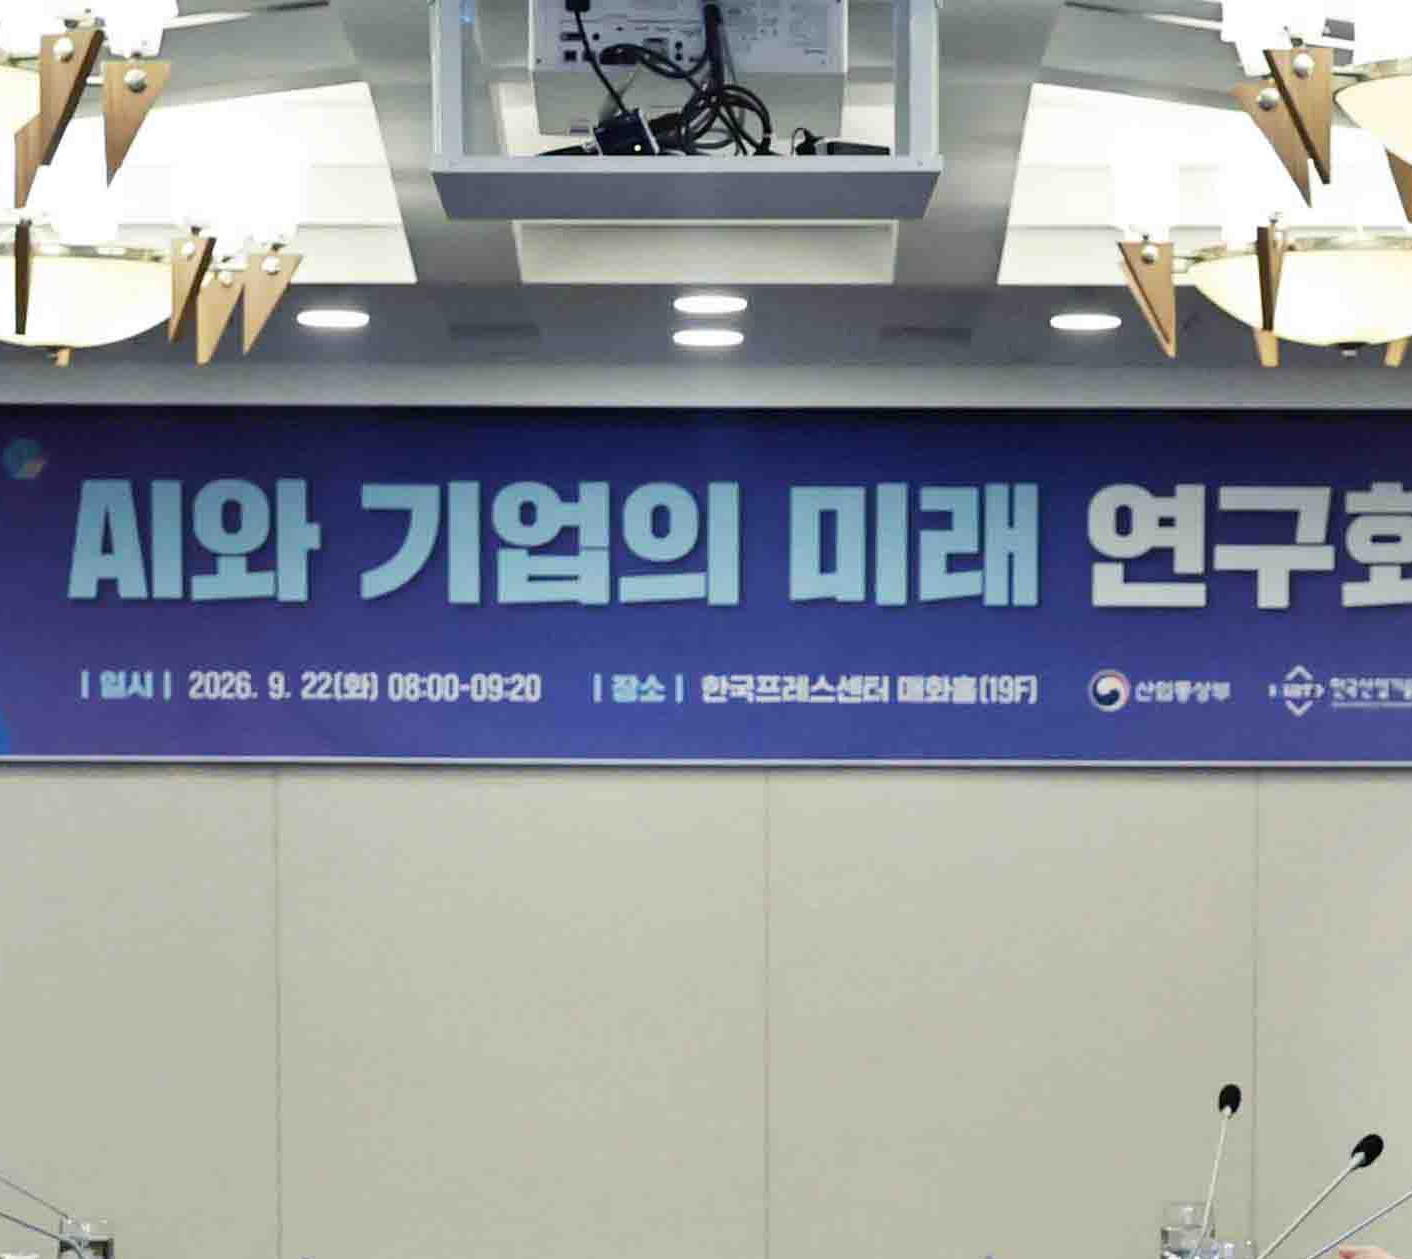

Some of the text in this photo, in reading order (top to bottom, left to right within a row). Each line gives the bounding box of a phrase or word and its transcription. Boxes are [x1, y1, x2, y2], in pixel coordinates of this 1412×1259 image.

[67, 478, 320, 602] AI와
[361, 480, 740, 606] 기업의
[789, 481, 1040, 607] 미래
[100, 669, 542, 702] 일시 2026. 9. 22(화) 08:00-09:20
[611, 673, 665, 703] 장소
[701, 673, 890, 704] 한국프레스센터
